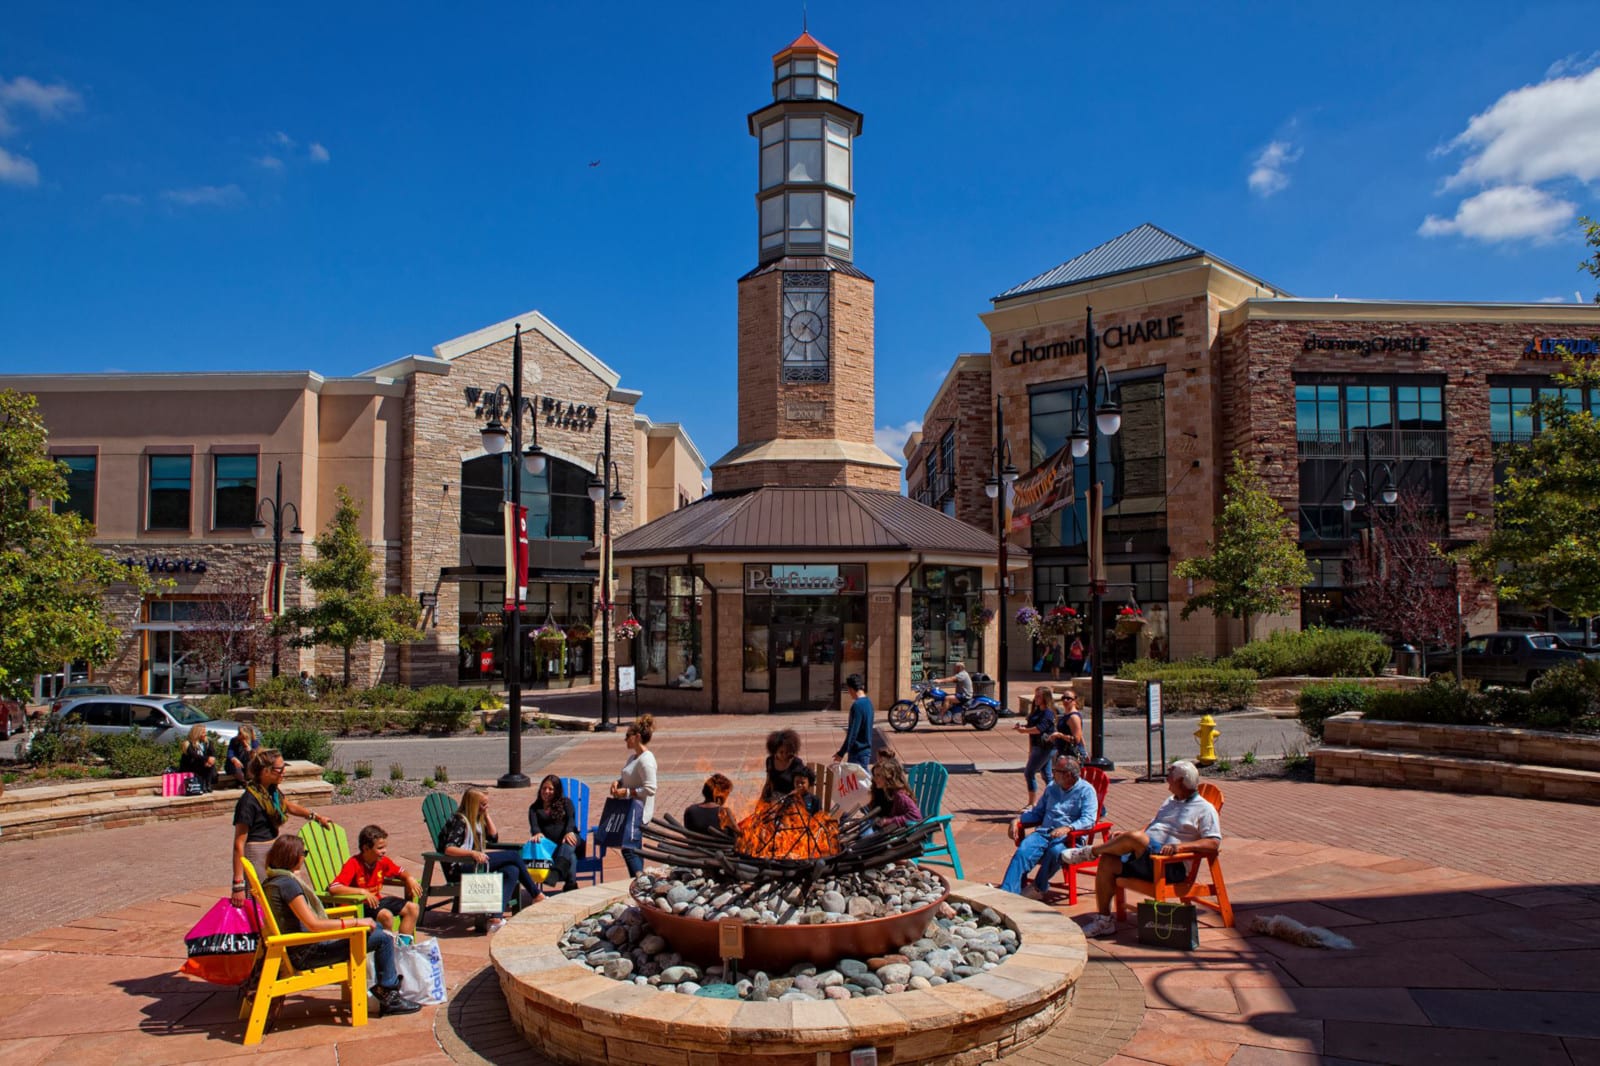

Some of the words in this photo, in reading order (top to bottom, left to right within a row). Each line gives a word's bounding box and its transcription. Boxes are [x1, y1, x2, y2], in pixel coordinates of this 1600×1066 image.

[1103, 315, 1184, 349] CHARLIE
[1304, 334, 1371, 358] charming
[1372, 337, 1430, 351] CHARLIE
[541, 396, 598, 420] BLACK
[545, 414, 595, 432] MARKET
[145, 556, 207, 573] Works
[750, 568, 845, 591] Perfume
